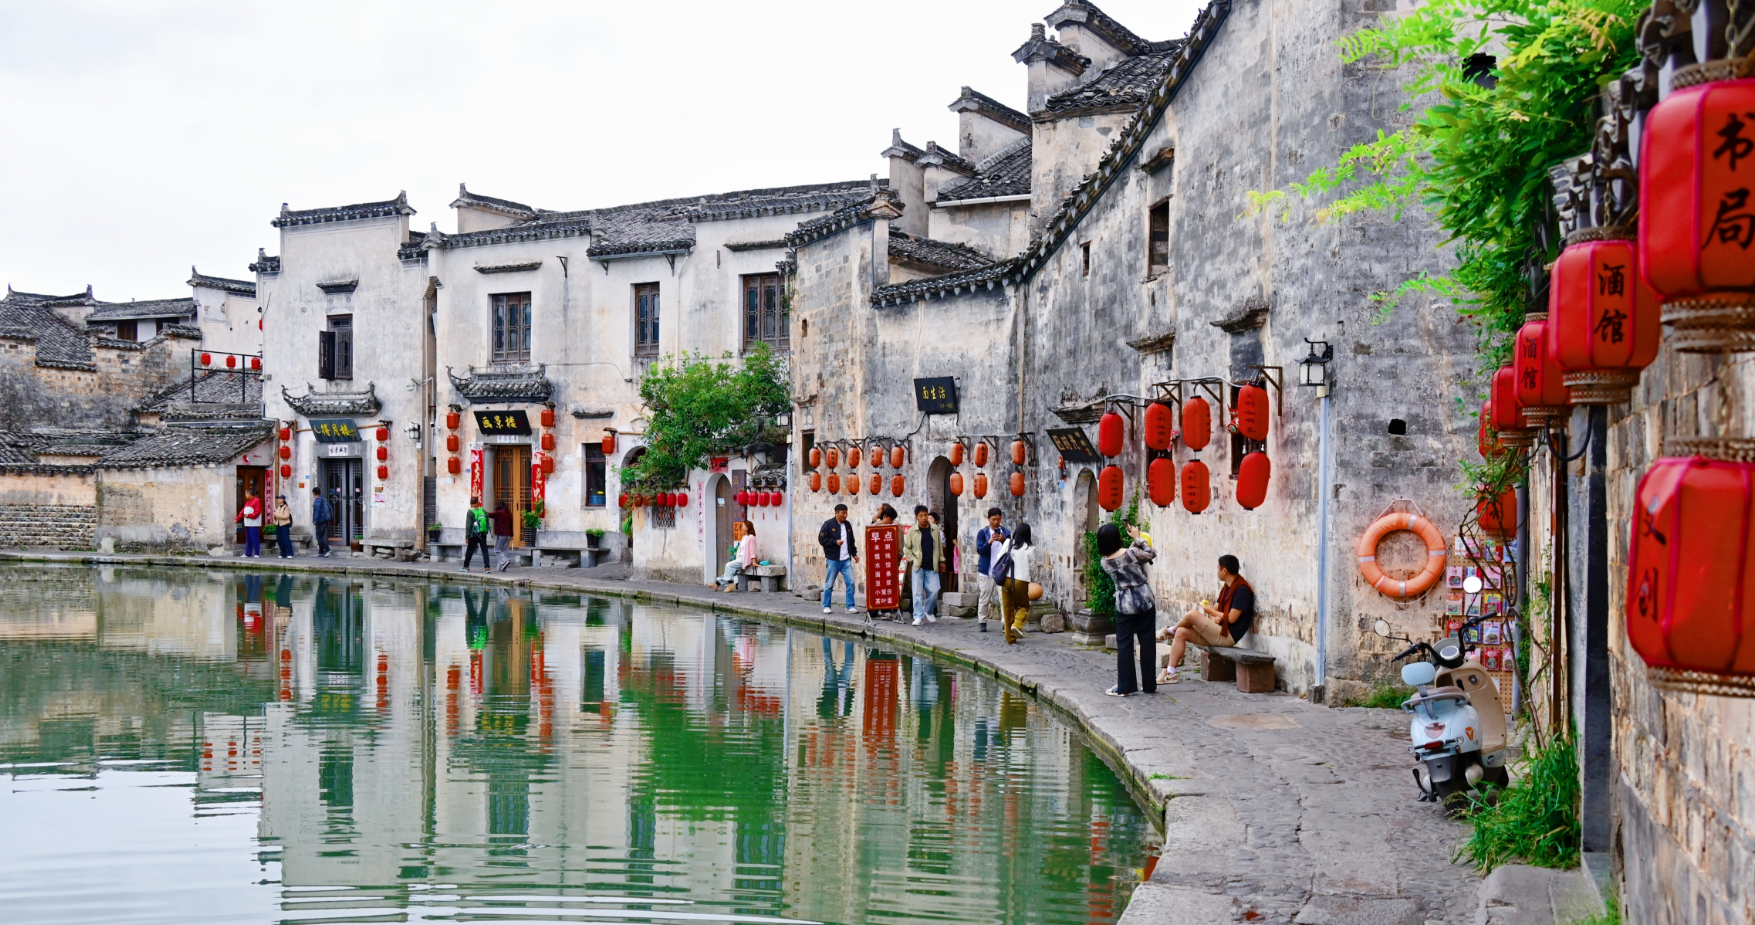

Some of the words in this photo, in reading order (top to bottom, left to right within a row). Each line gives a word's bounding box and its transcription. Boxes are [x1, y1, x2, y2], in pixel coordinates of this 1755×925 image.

[1701, 112, 1755, 250] 书局
[1594, 263, 1627, 345] 酒馆
[1520, 336, 1539, 390] 酒馆
[922, 385, 946, 400] 面生活
[1051, 434, 1081, 451] 旧时光
[870, 531, 893, 543] 早点
[874, 543, 891, 551] 米粥
[875, 561, 891, 569] 水饺
[875, 570, 891, 578] 面条
